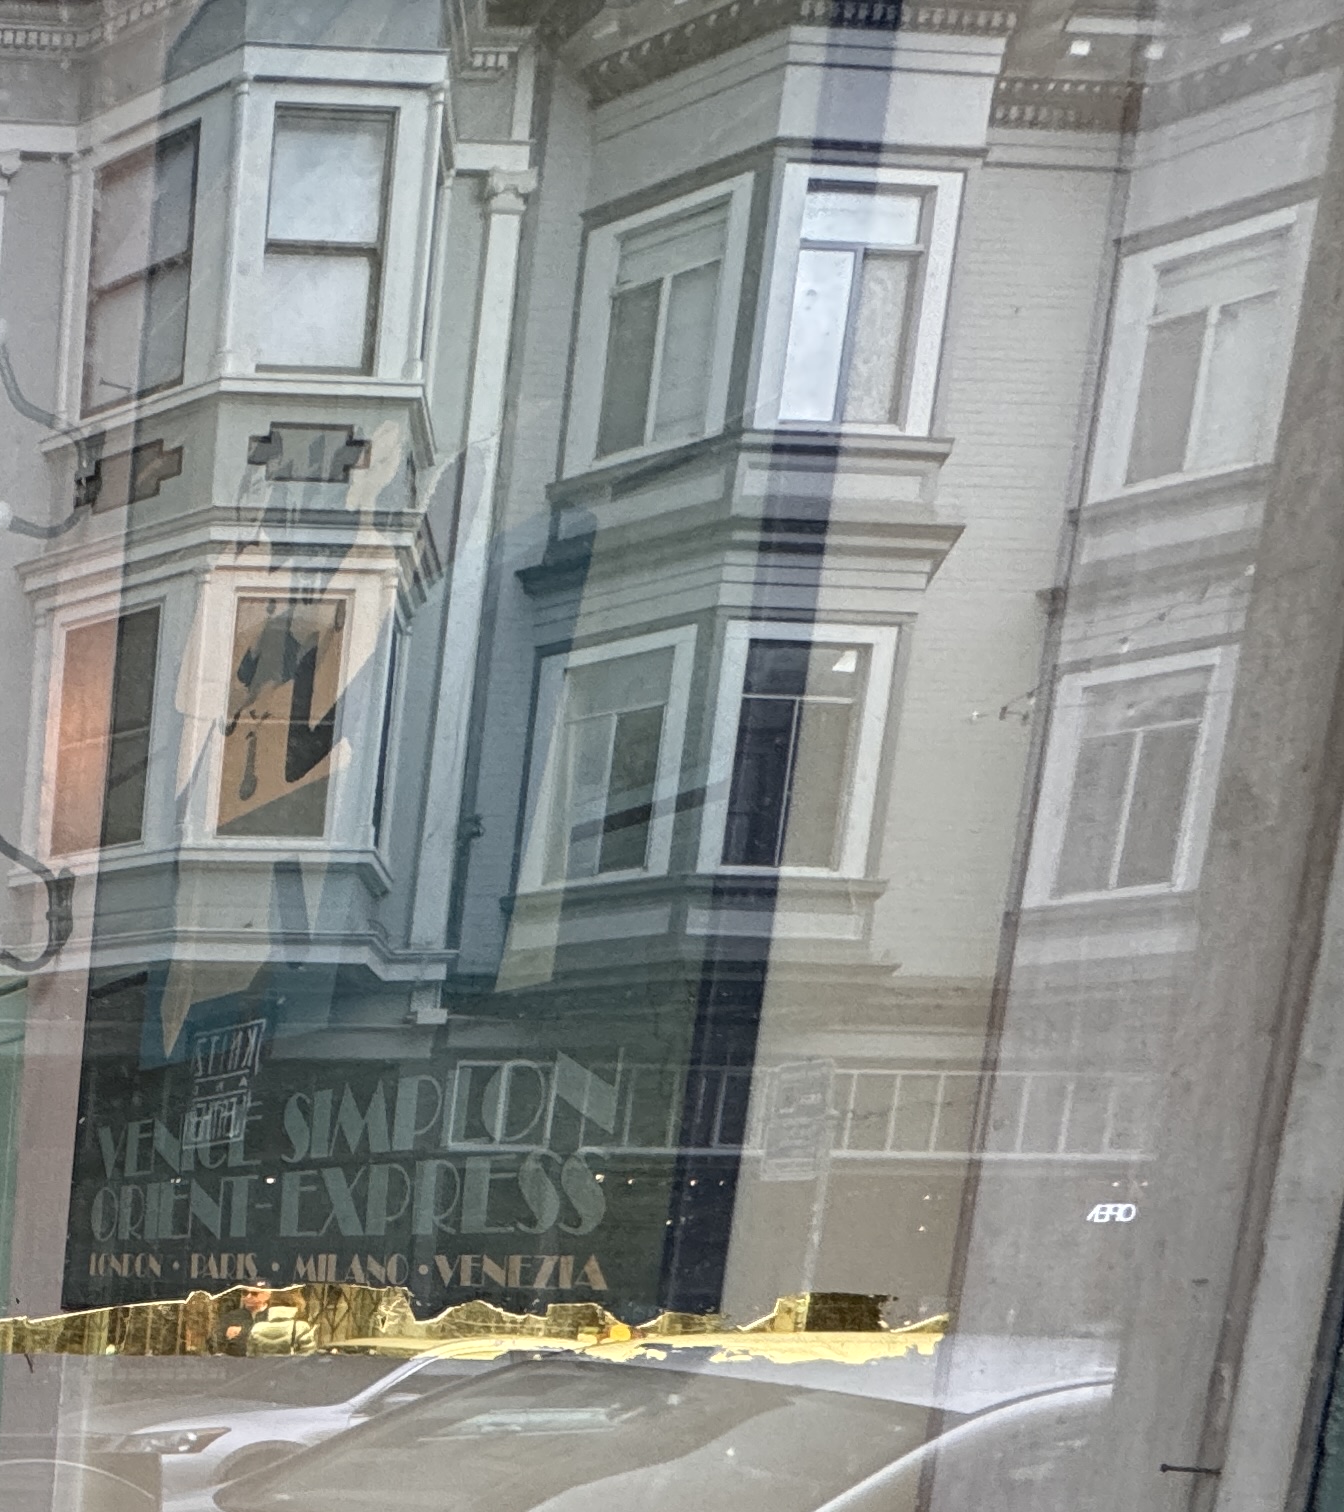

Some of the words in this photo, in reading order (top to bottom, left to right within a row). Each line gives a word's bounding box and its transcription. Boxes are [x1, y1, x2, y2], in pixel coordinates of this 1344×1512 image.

[98, 1100, 262, 1180] VENICE
[281, 1047, 625, 1165] SIMPLON
[90, 1149, 610, 1244] ORIENT-EXPRESS
[89, 1252, 163, 1278] LONDON
[191, 1252, 259, 1280] PARIS
[293, 1253, 411, 1285] MILANO
[435, 1254, 610, 1292] VENEZIA
